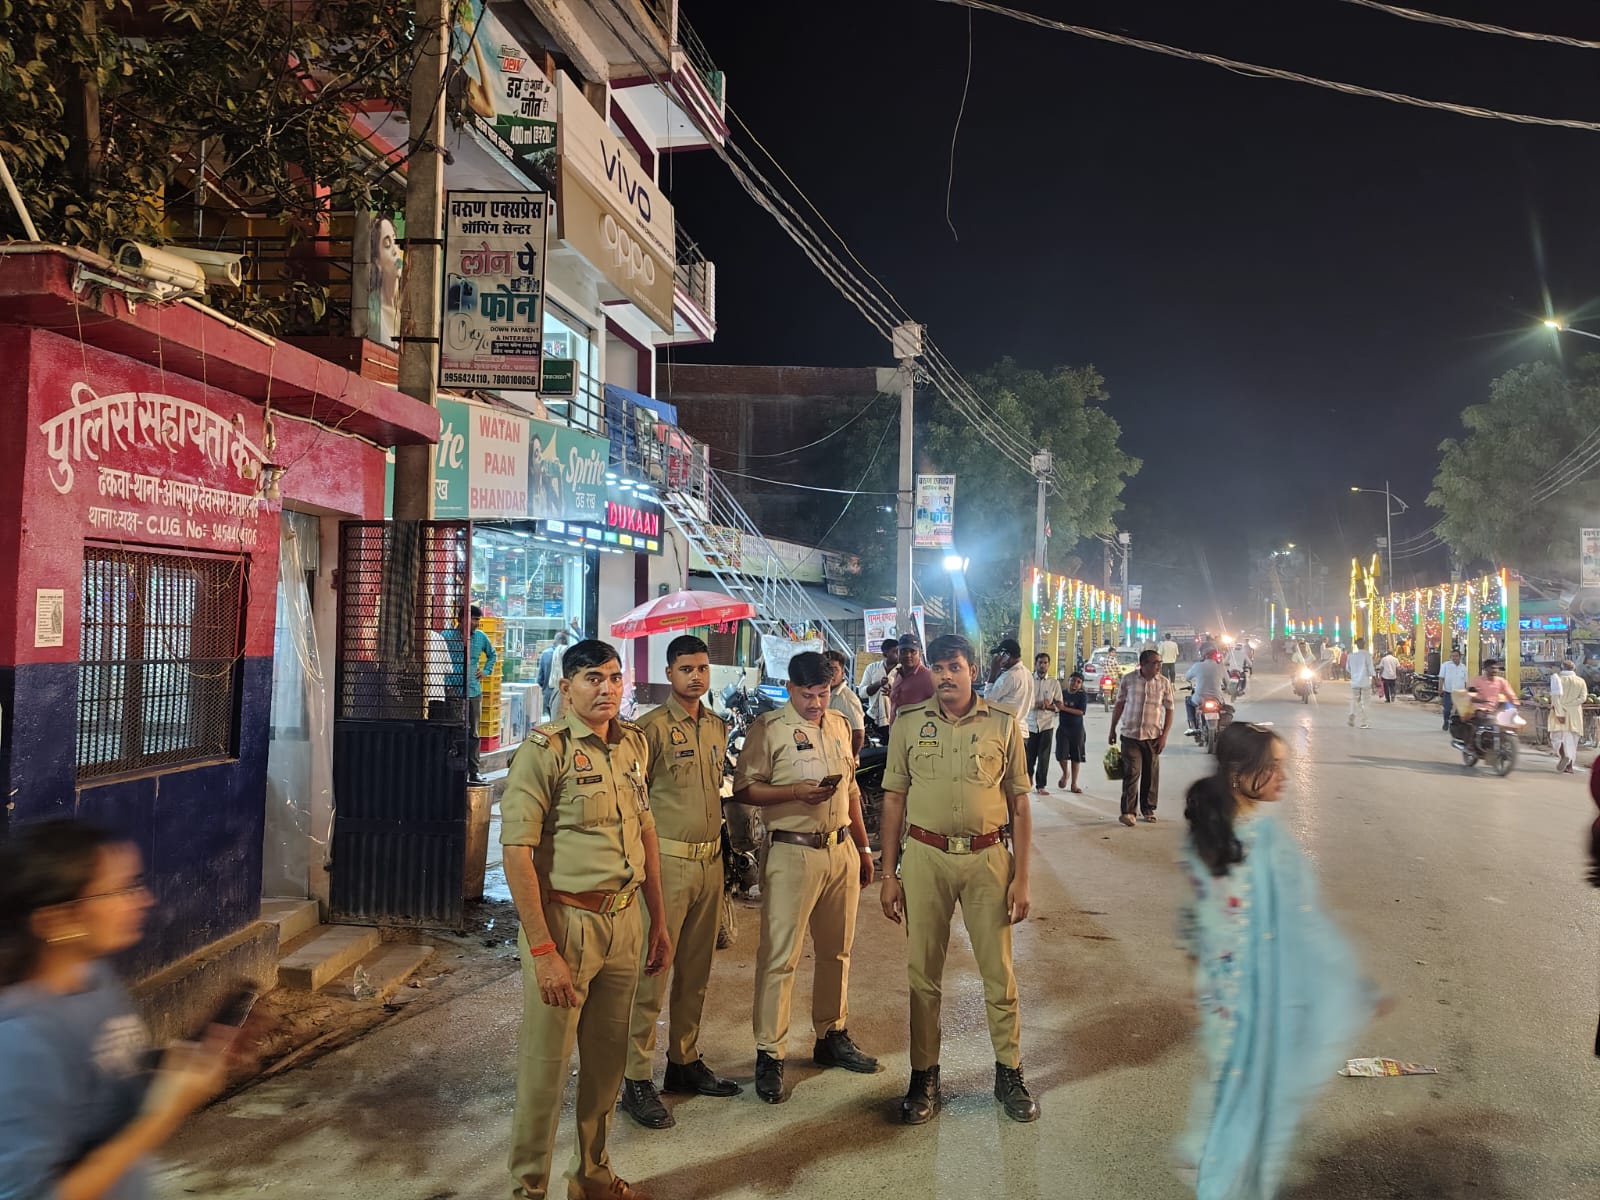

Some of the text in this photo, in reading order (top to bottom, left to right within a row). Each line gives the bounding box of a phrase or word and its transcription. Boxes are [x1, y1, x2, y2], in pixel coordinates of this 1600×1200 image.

[521, 91, 543, 118] जीत
[600, 139, 651, 223] vivo
[490, 196, 544, 219] एक्सप्रेस
[460, 241, 537, 277] लोन पे
[605, 214, 655, 286] oppo
[480, 284, 539, 323] फोन
[40, 381, 137, 494] पुलिस
[137, 392, 233, 470] सहायता
[479, 415, 520, 443] WATAN
[484, 452, 516, 477] PAAN
[566, 447, 606, 492] Sprite
[470, 487, 526, 512] BHANDAR
[147, 515, 183, 537] C.U.G.
[608, 501, 659, 537] DUKAAN
